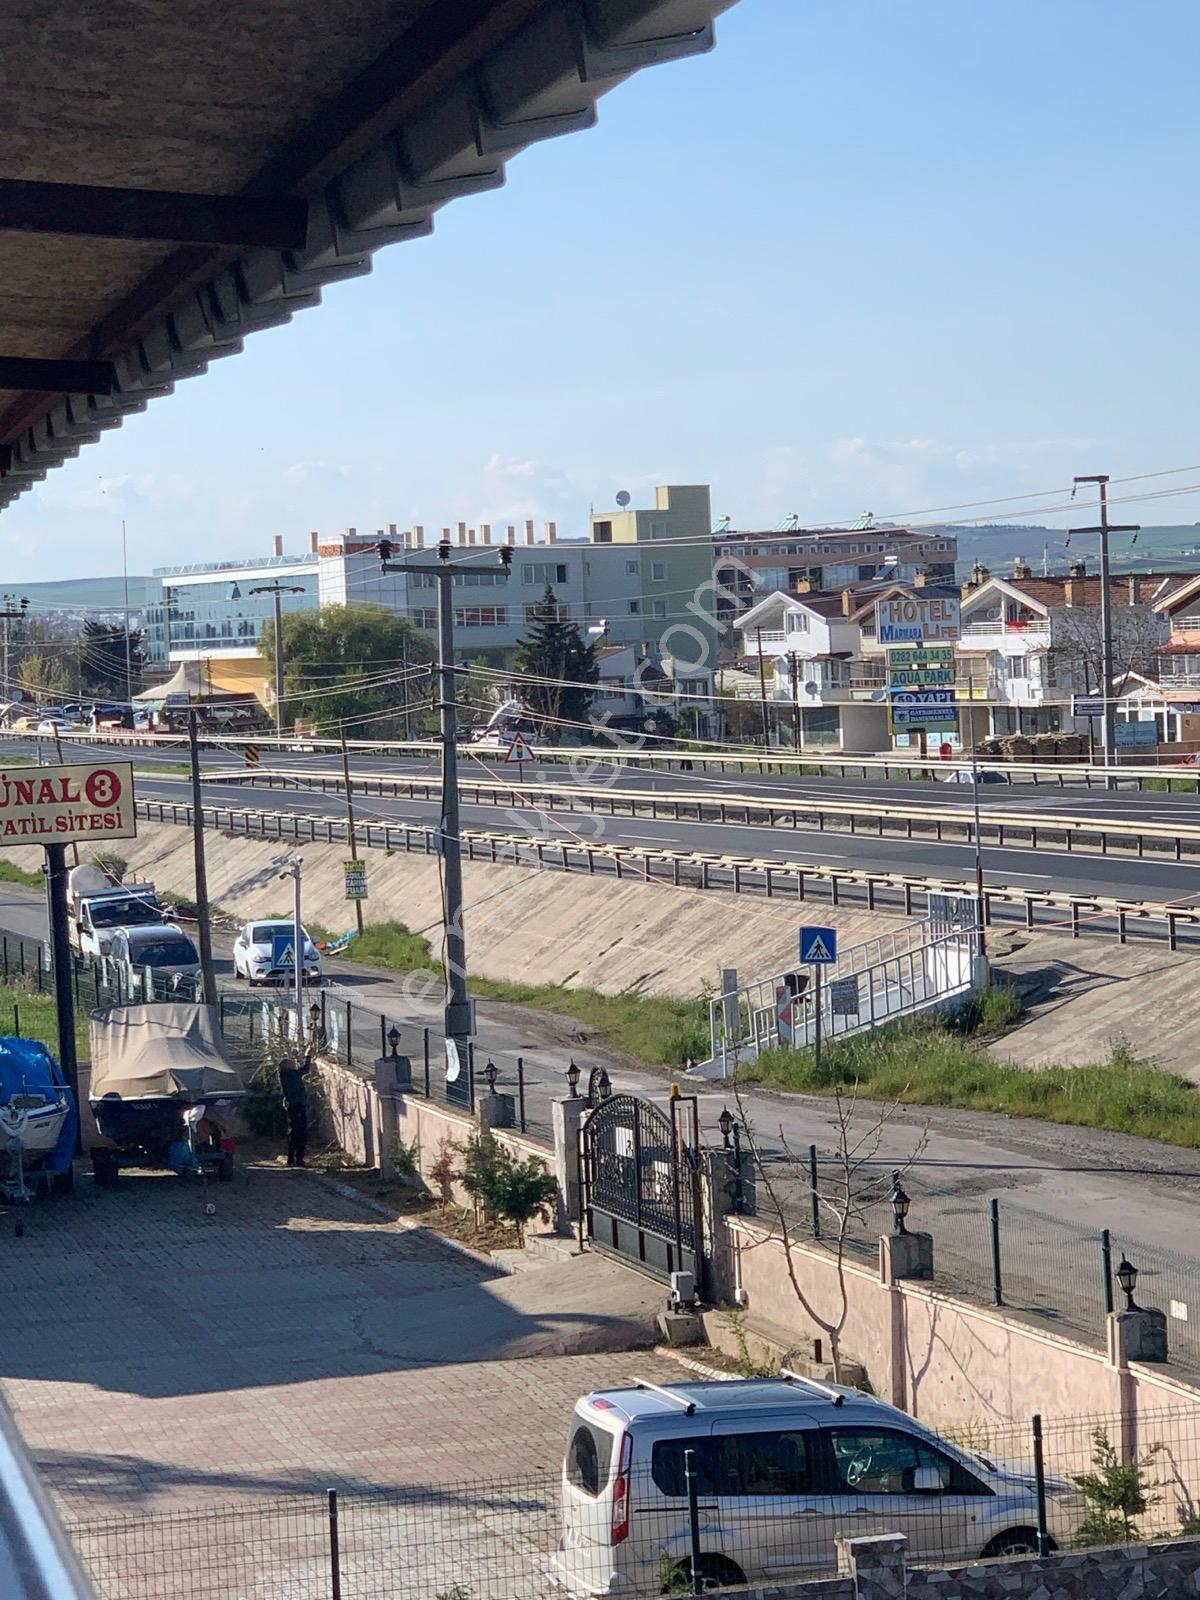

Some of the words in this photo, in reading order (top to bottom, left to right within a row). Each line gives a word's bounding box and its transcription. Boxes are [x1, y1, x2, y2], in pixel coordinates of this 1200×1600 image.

[892, 671, 921, 685] AQUA
[924, 670, 952, 683] PARK
[0, 812, 53, 836] ATİL
[55, 806, 124, 833] SİTESİ
